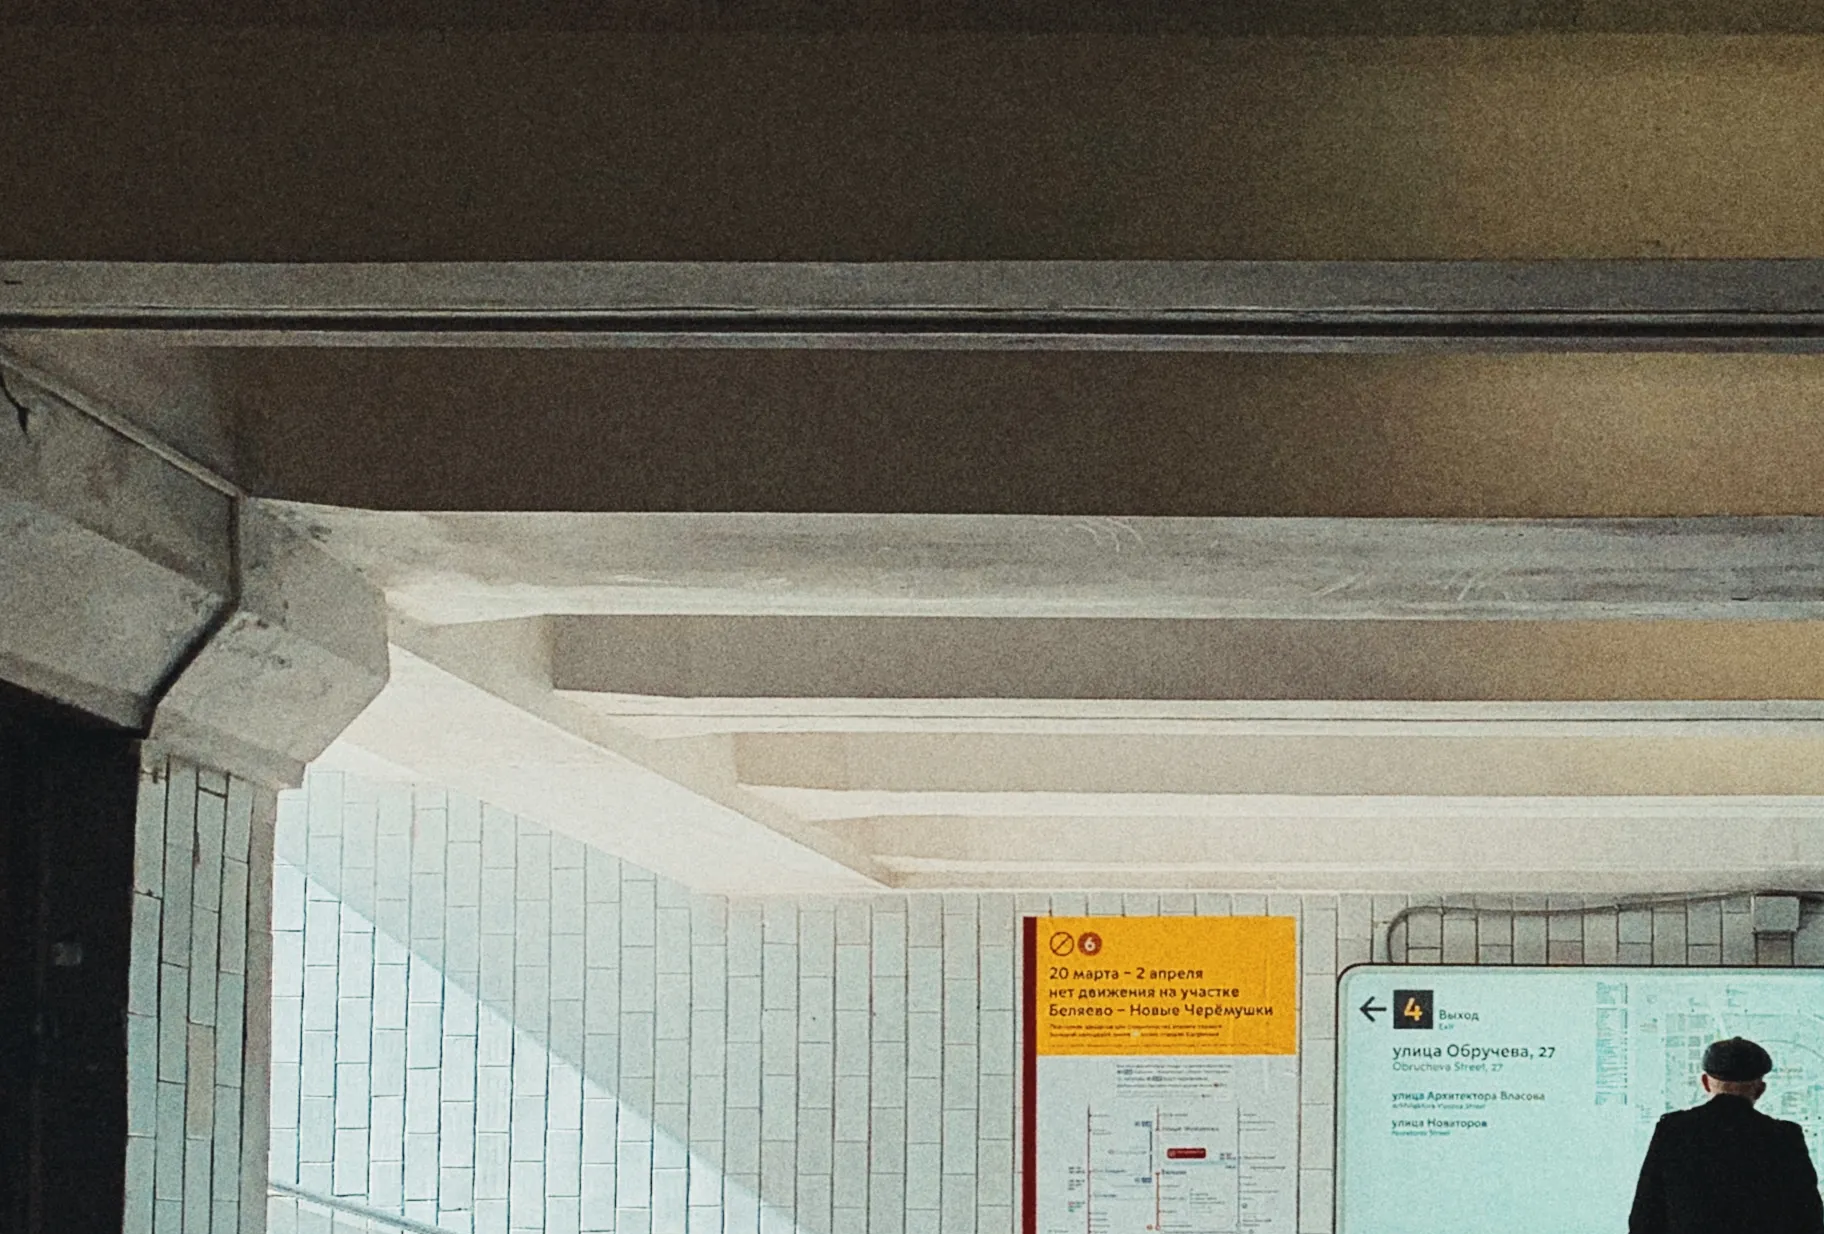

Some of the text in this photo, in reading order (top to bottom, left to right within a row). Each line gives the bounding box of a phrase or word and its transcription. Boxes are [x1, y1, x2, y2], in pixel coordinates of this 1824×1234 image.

[1084, 938, 1095, 950] 6
[1049, 968, 1068, 979] 20
[1073, 970, 1118, 981] марта
[1137, 968, 1144, 979] 2
[1150, 970, 1203, 981] апреля
[1049, 988, 1239, 1000] нет движения на участке
[1049, 1004, 1113, 1016] Беляево
[1131, 1005, 1179, 1016] Новые
[1185, 1004, 1273, 1018] Черёмушки
[1404, 998, 1423, 1021] 4
[1439, 1010, 1480, 1022] Выход
[1393, 1045, 1556, 1060] улица Обручева, 27
[1455, 1062, 1487, 1072] Street,
[1491, 1063, 1503, 1071] 27
[1392, 1091, 1545, 1102] улица Архитектора Власова
[1392, 1118, 1488, 1129] улица Новаторов
